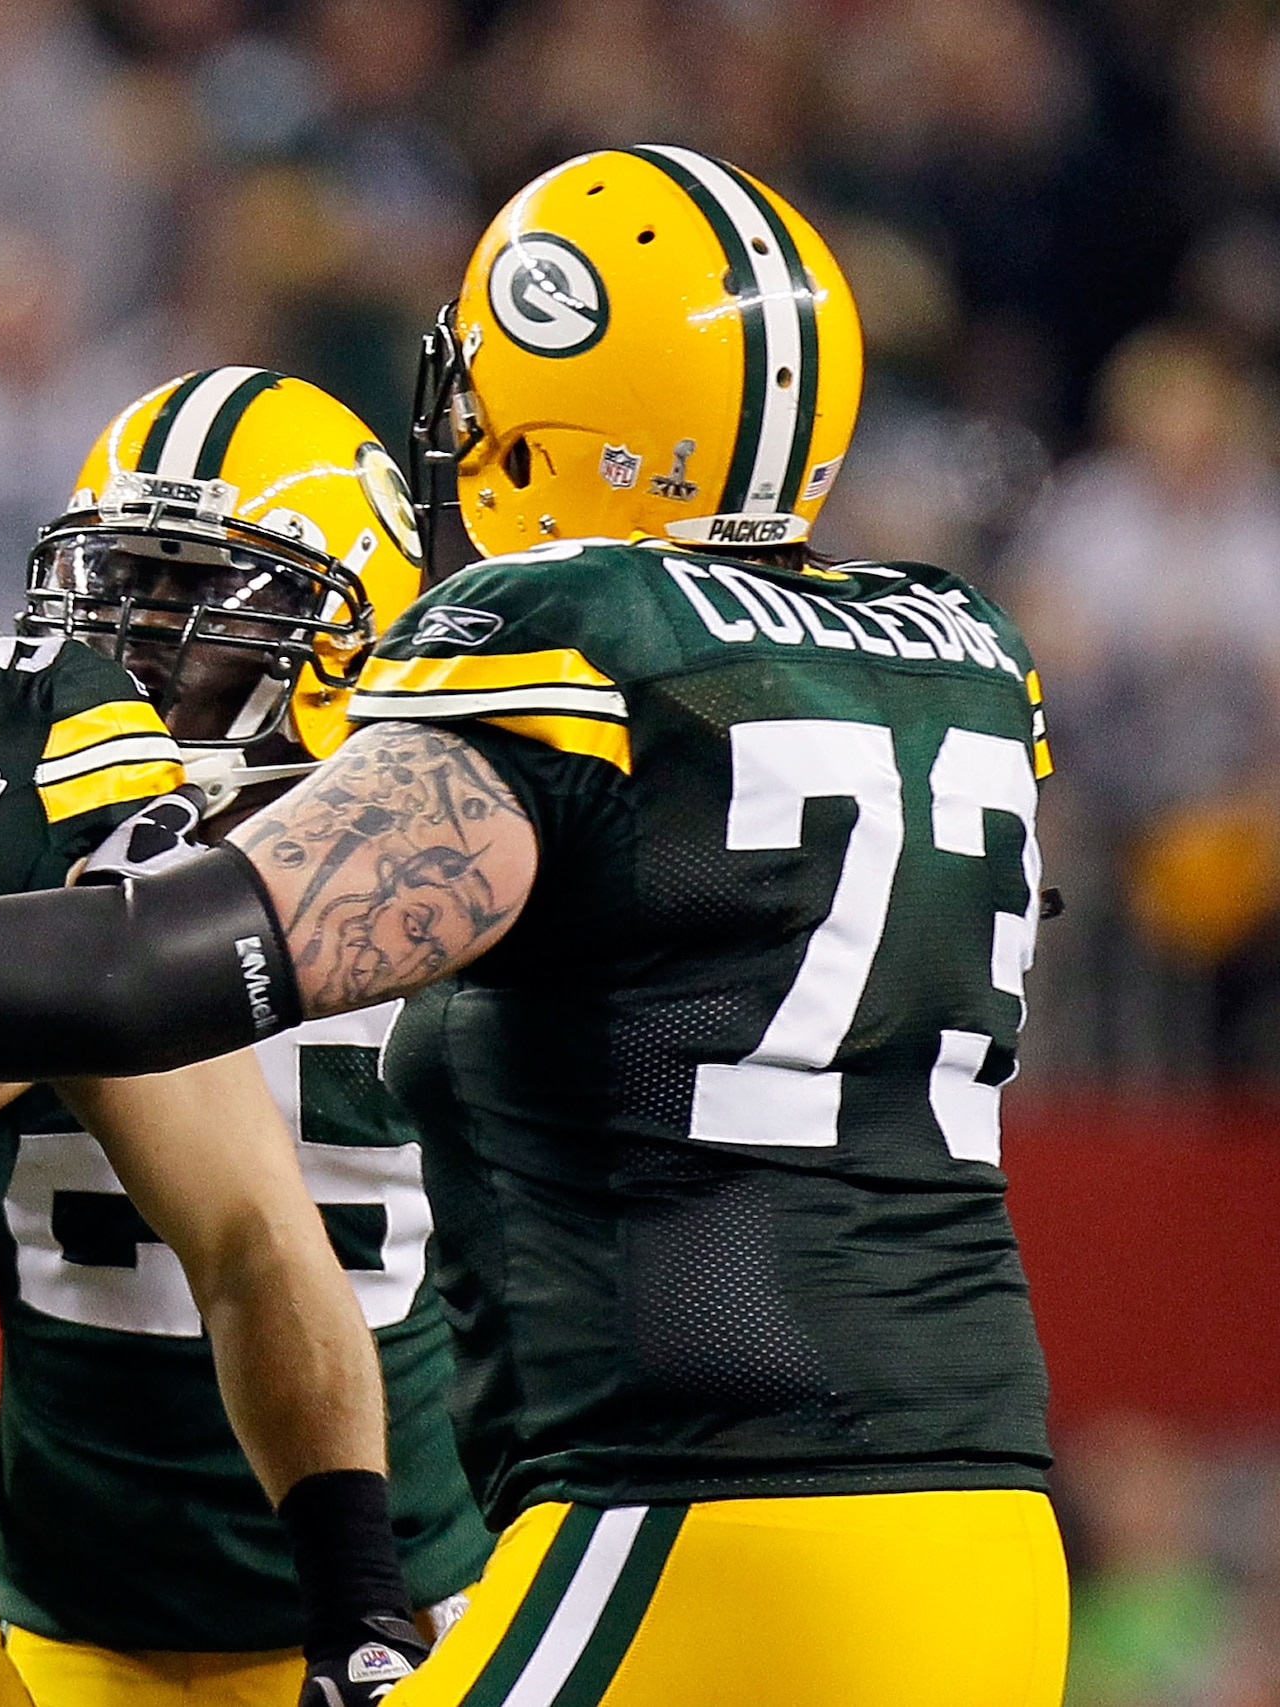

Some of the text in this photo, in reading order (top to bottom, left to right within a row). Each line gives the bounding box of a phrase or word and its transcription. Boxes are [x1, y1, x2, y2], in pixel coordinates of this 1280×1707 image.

[487, 236, 602, 353] G
[603, 461, 634, 485] NFL
[708, 516, 789, 543] PACKERS
[662, 556, 1024, 683] COLLEDGE
[689, 718, 1043, 1168] 73
